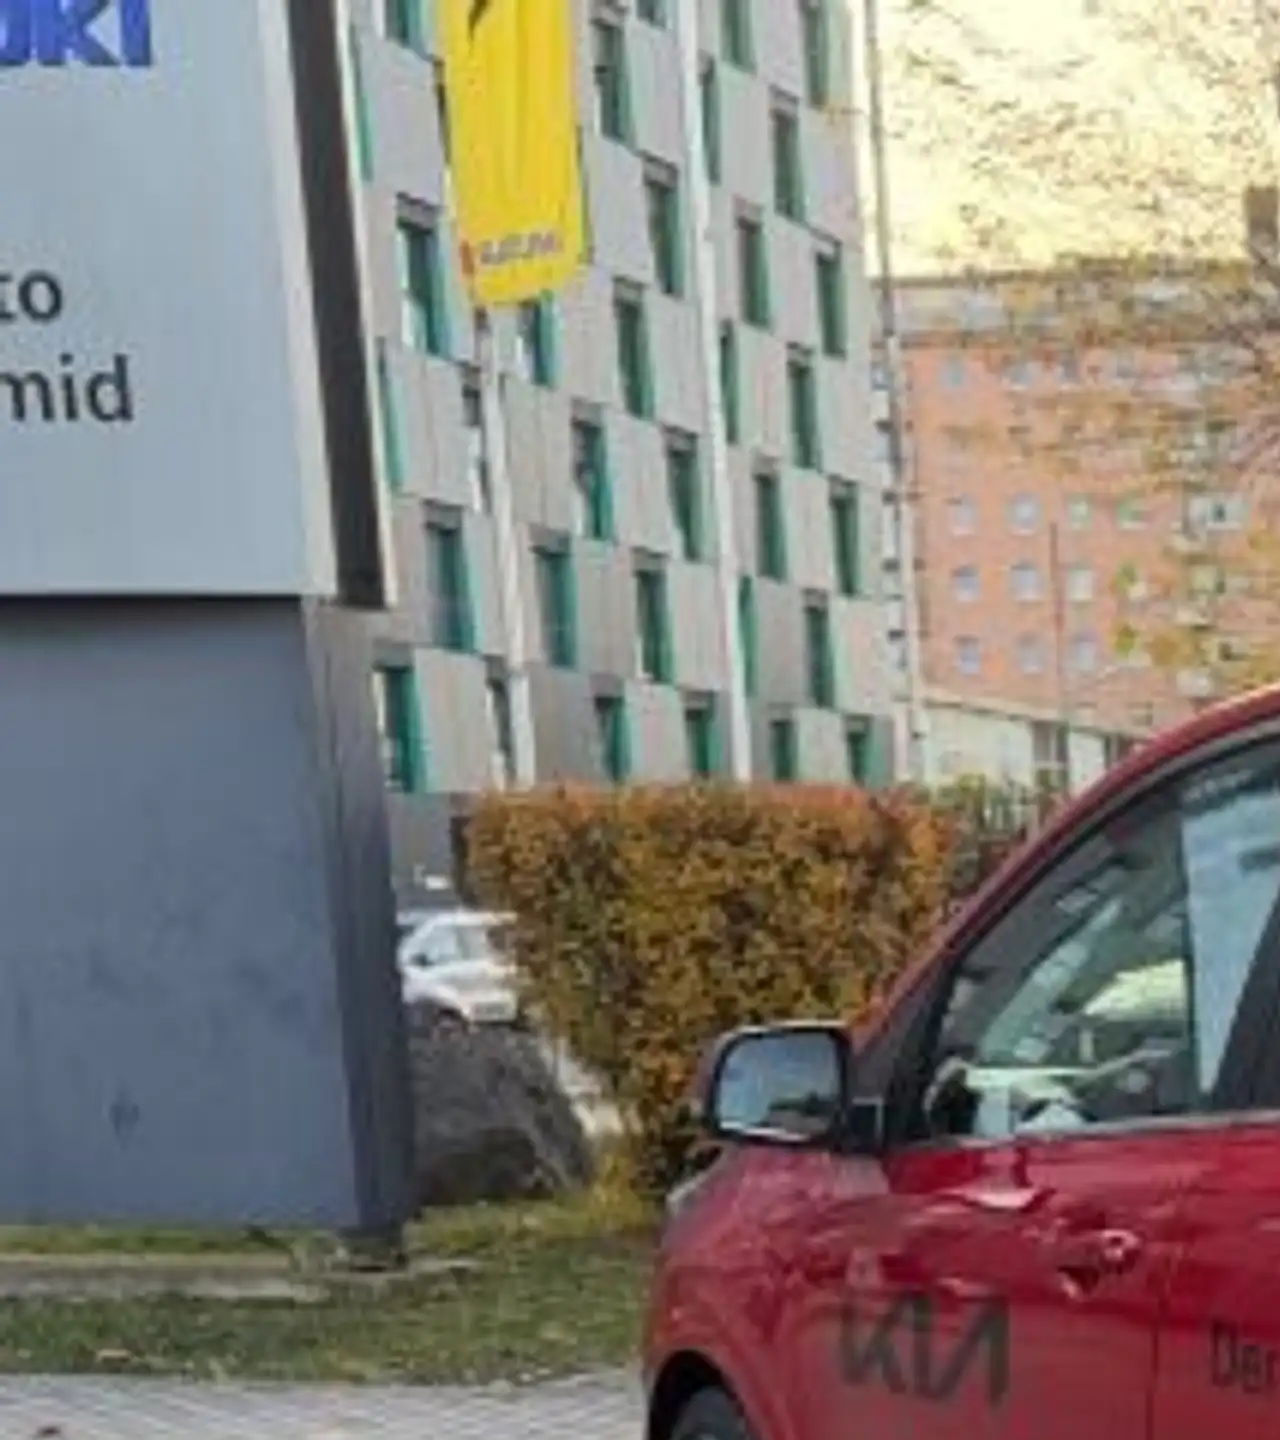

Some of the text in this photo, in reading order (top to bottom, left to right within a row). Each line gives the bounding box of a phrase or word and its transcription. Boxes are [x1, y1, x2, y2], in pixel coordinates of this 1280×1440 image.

[0, 352, 134, 423] mid
[838, 1290, 1011, 1408] KIA
[1210, 1320, 1276, 1390] Der
